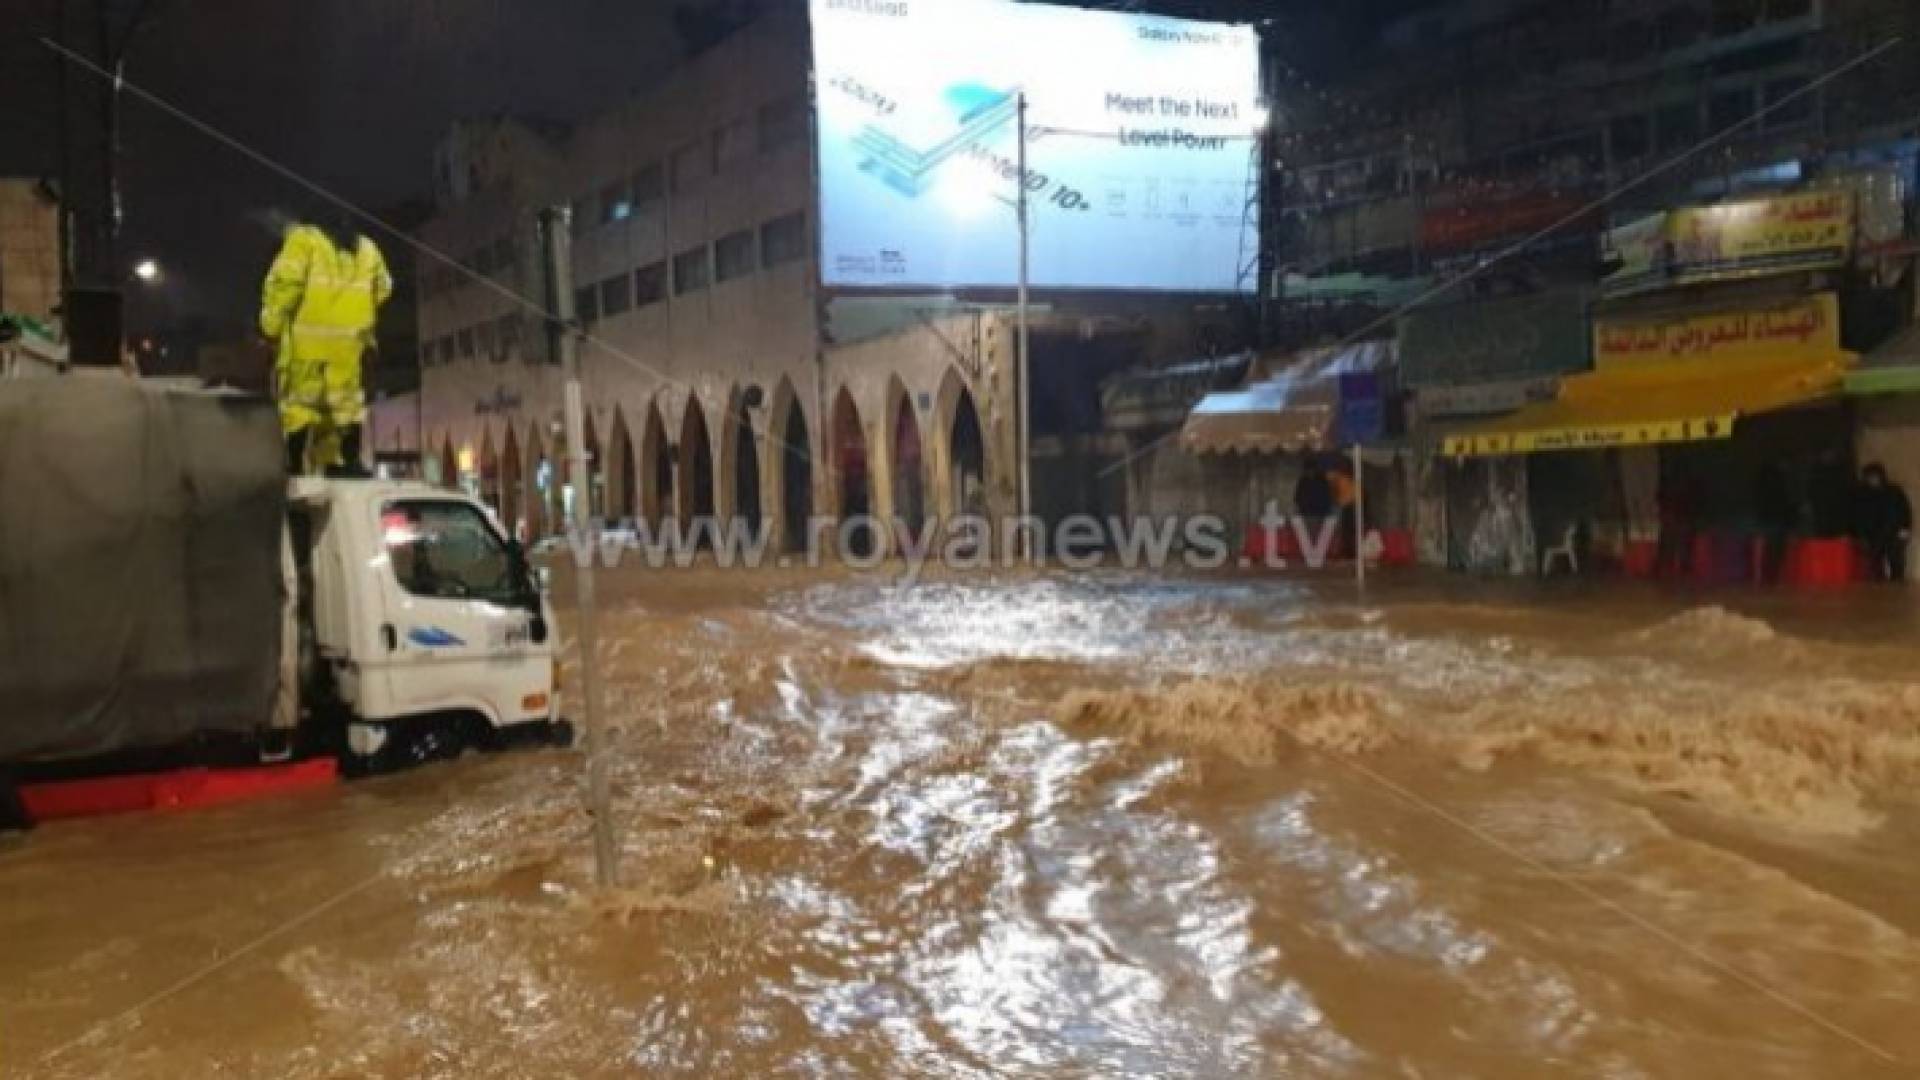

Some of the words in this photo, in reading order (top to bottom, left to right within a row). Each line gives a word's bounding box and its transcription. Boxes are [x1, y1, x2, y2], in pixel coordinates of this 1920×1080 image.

[1105, 92, 1153, 114] Meet
[1159, 95, 1192, 117] the
[1195, 97, 1238, 120] Next
[1119, 127, 1169, 148] Level
